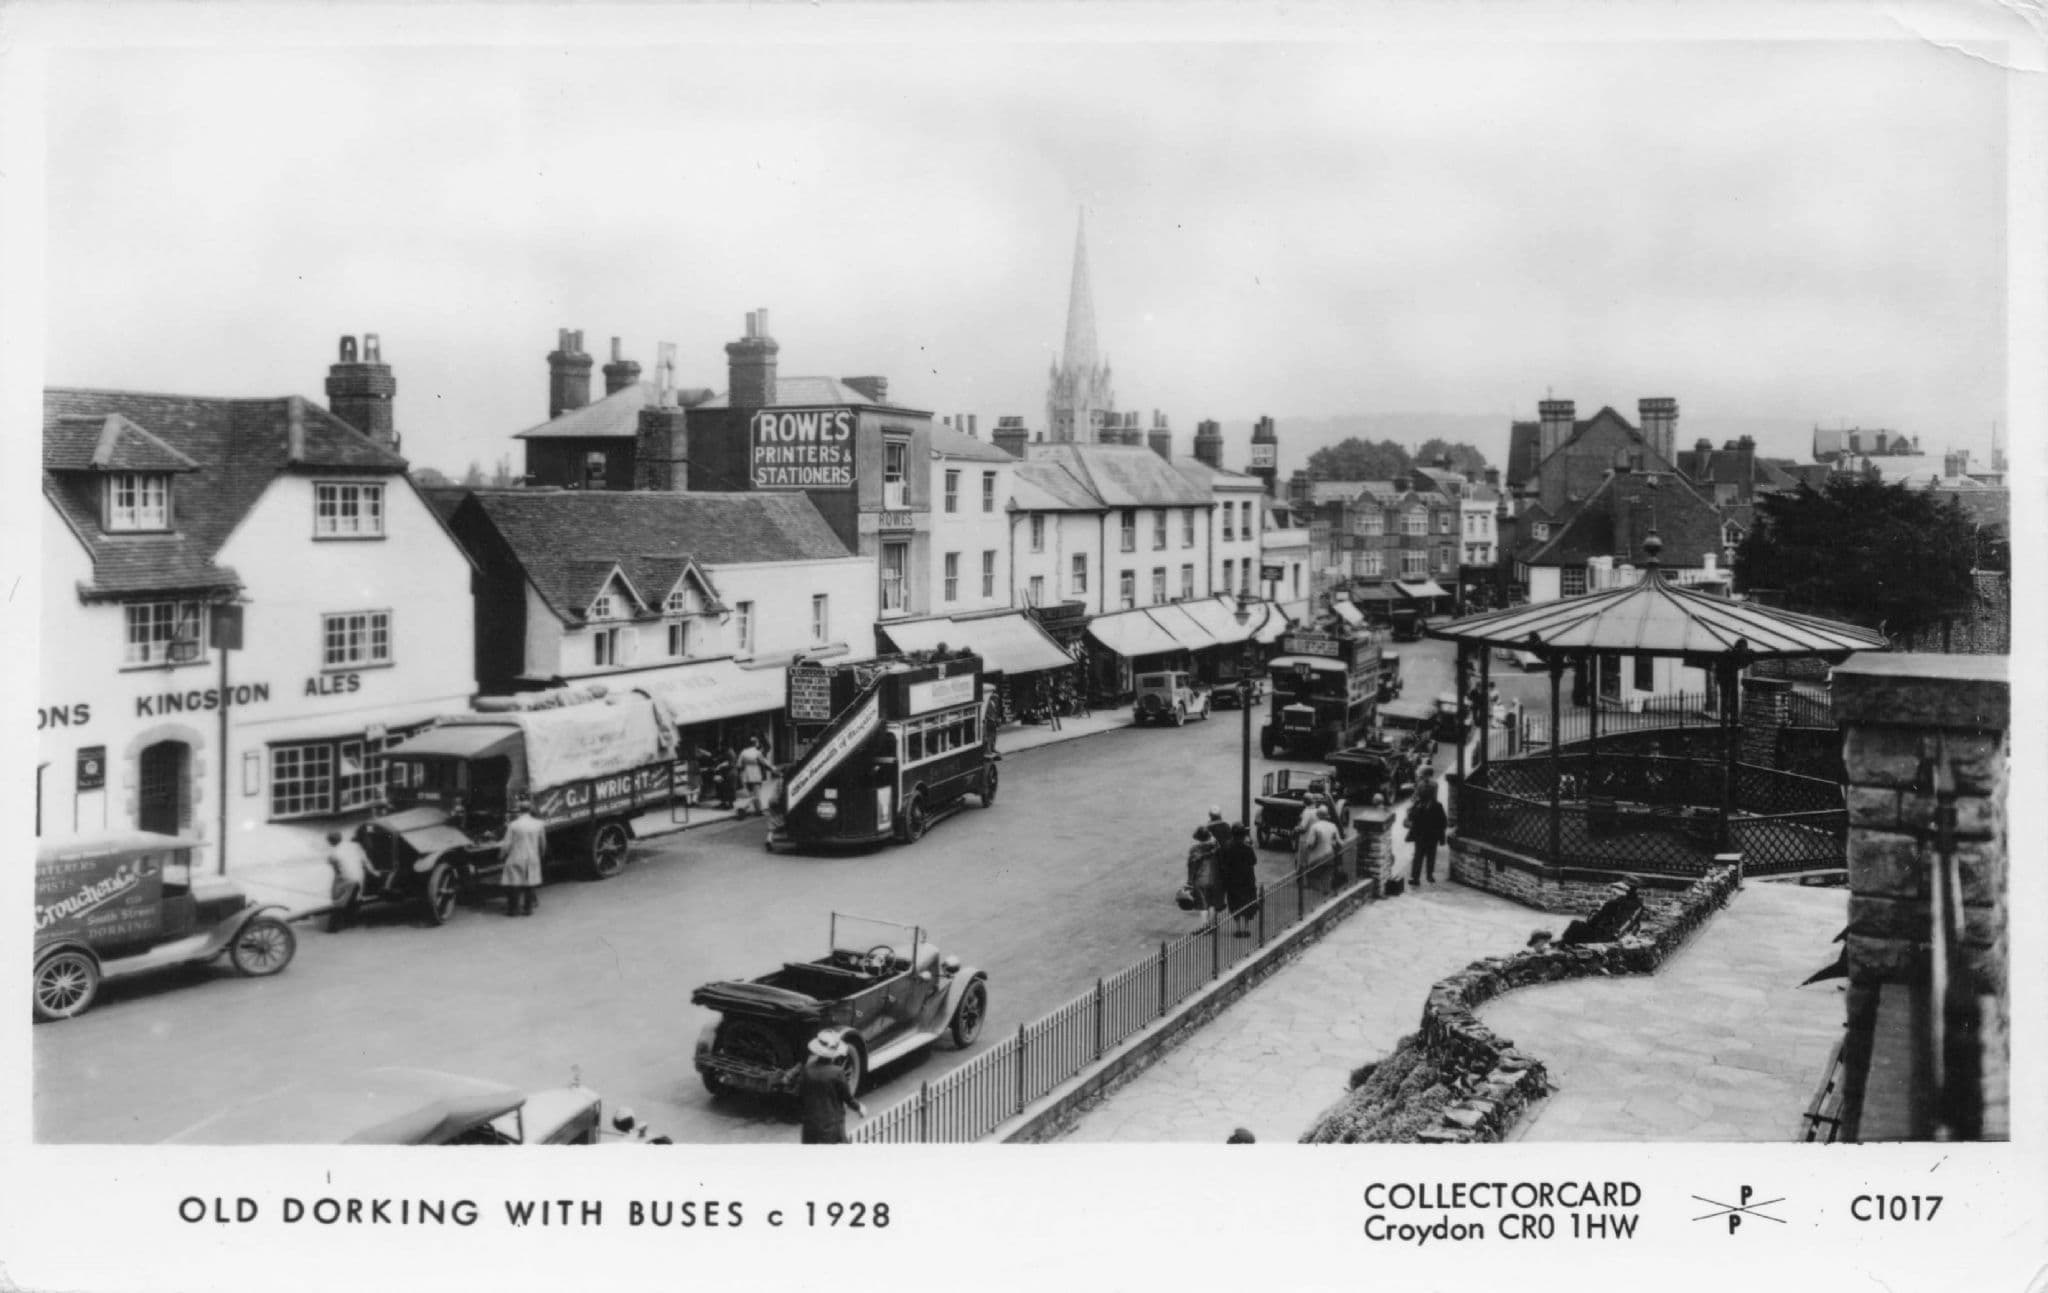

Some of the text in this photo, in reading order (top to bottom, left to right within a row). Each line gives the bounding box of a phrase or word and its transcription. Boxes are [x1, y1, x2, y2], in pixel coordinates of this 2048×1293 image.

[760, 411, 850, 442] ROWES
[755, 446, 852, 463] PRINTERS &
[758, 466, 850, 484] STATIONERS
[878, 511, 913, 526] ROWES
[136, 683, 269, 718] KINGSTON
[304, 674, 360, 697] ALES
[87, 917, 153, 938] DORKING
